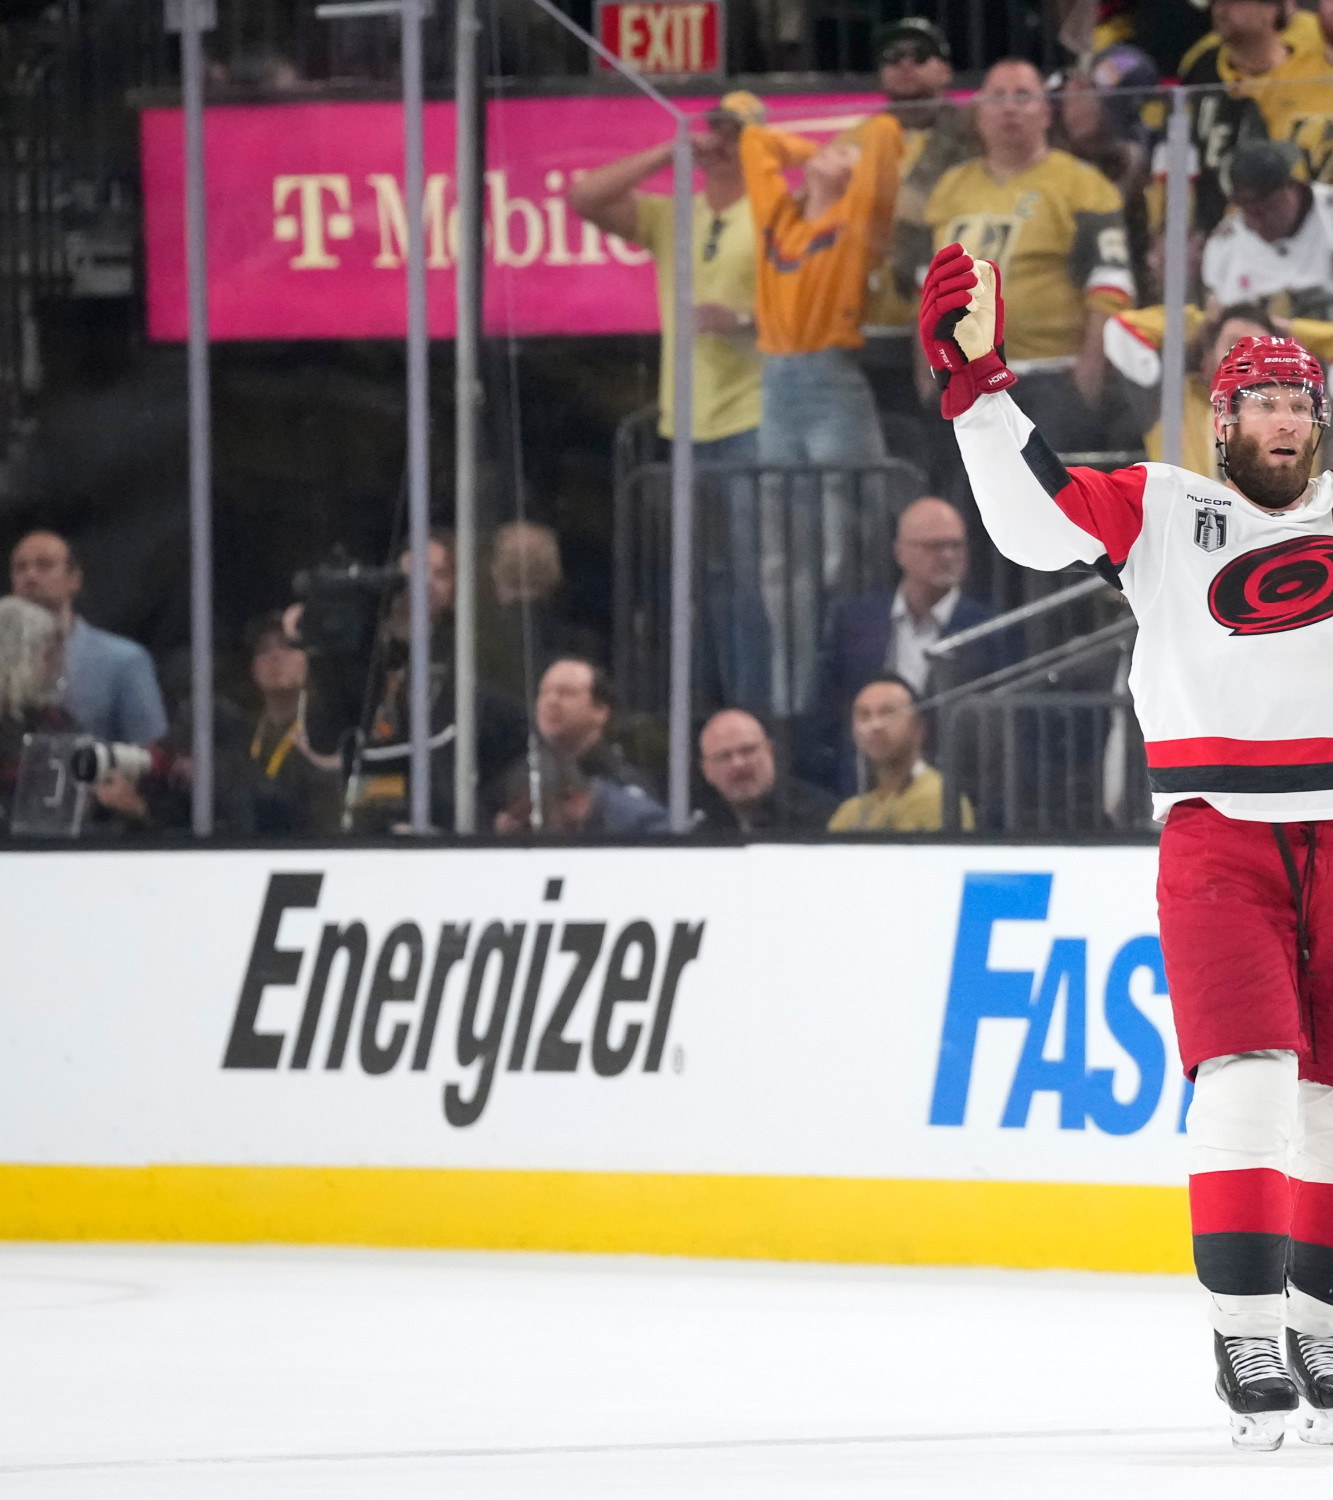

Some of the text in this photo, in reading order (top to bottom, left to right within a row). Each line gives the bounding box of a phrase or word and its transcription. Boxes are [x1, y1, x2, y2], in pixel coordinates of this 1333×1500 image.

[620, 5, 709, 72] EXIT
[987, 370, 1009, 387] MACH
[1186, 493, 1232, 507] NUCOR
[220, 870, 706, 1129] Energizer
